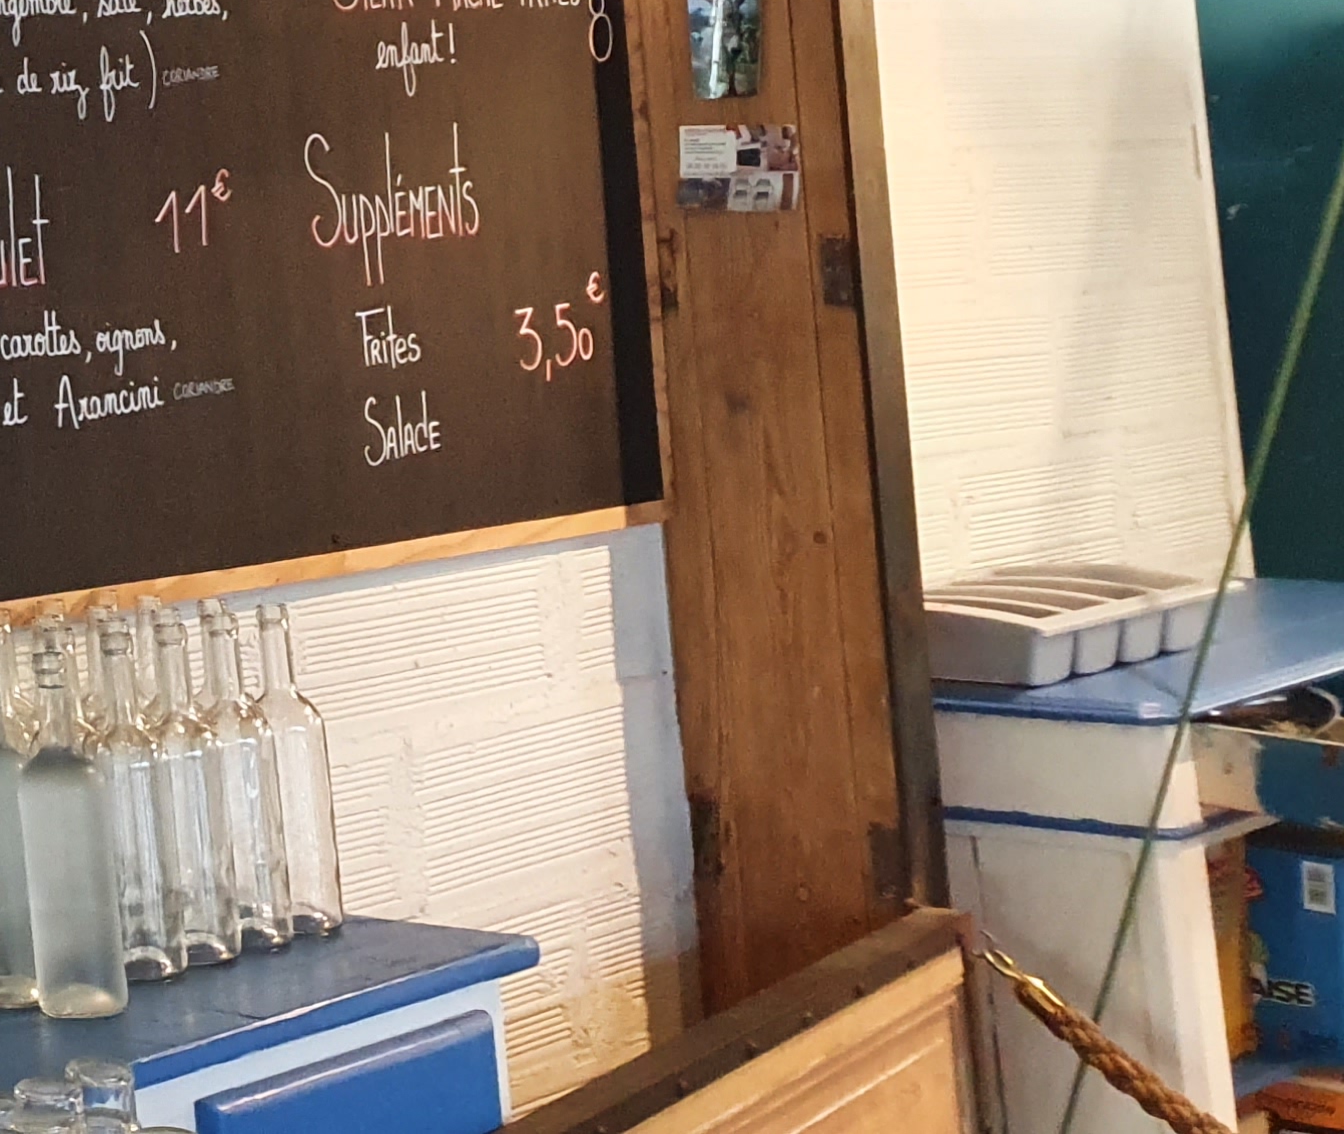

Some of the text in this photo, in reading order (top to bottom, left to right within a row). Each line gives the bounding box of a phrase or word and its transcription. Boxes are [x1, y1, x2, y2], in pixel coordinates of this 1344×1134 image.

[17, 58, 43, 94] de
[49, 66, 89, 121] riz
[3, 378, 27, 428] et
[54, 374, 164, 430] Arancini
